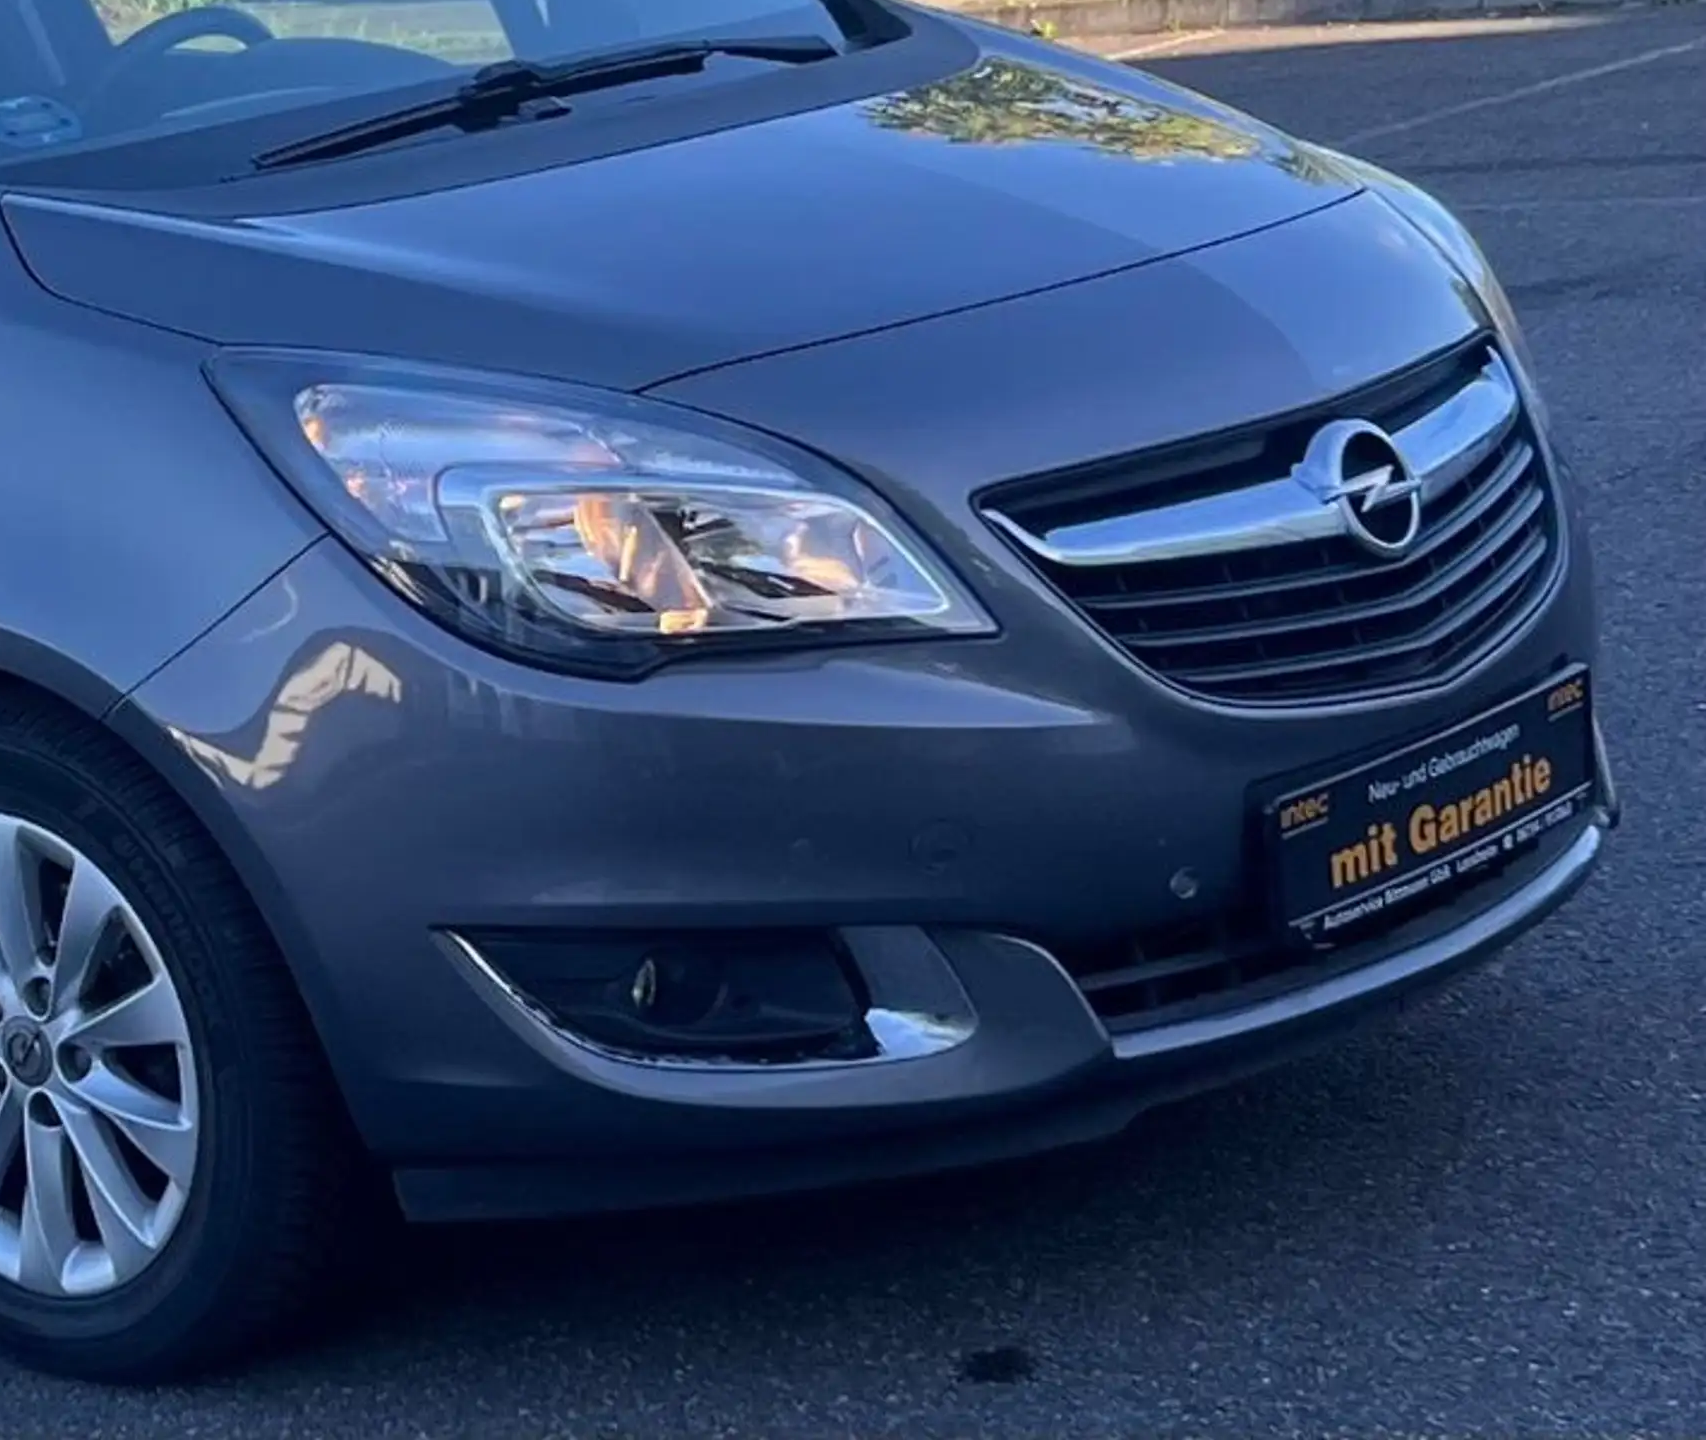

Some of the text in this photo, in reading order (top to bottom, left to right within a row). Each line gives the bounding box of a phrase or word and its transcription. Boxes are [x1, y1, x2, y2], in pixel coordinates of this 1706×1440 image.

[1368, 723, 1520, 803] Neu- und Gebrauchtwagen
[1330, 822, 1398, 889] mit
[1408, 753, 1552, 855] Garantie
